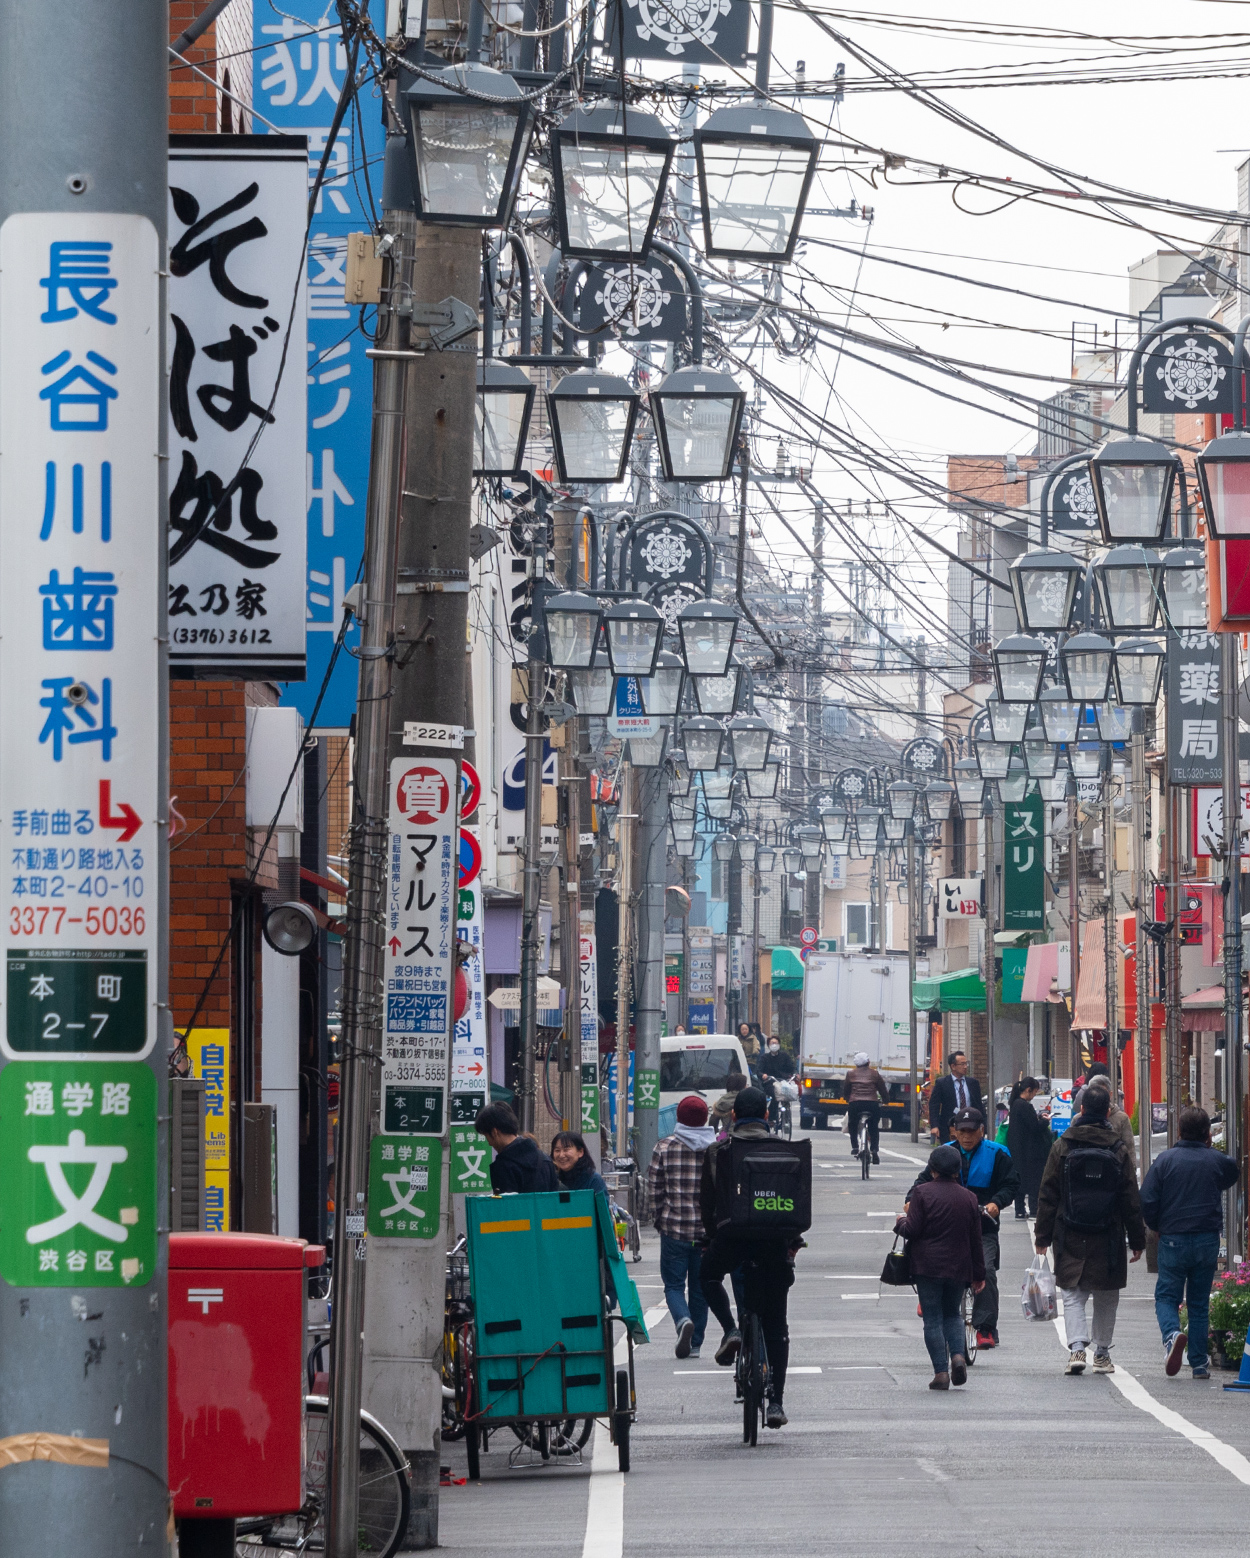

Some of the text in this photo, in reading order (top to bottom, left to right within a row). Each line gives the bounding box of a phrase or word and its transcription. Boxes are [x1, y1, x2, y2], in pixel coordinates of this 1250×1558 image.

[169, 181, 281, 568] そば処
[39, 241, 119, 763] 長谷川歯科
[173, 627, 272, 644] (3376)3612
[418, 728, 446, 740] 222
[401, 773, 445, 817] 質
[12, 809, 95, 836] 手前曲る
[12, 848, 144, 870] 不動通り路地入る
[12, 875, 144, 898] 本町2-40-10
[389, 834, 402, 931] 自転車販売しています
[403, 834, 437, 957] マルス
[9, 906, 146, 936] 3377-5036
[804, 932, 814, 941] 30
[473, 926, 482, 982] 医療人社団
[394, 965, 443, 978] 夜9時まで
[29, 973, 123, 1001] 本町
[388, 979, 448, 992] 日曜祝日も営業
[388, 996, 446, 1008] ブランドバッグ
[501, 992, 550, 1000] ケアステン本町
[389, 1008, 445, 1020] パソコン・家電
[42, 1012, 109, 1039] 2-7
[388, 1020, 445, 1031] 商品券・引越品
[386, 1035, 447, 1047] 渋・本町6-17-1
[386, 1048, 446, 1060] 不動通り坂下信号前
[201, 1044, 224, 1116] 自民党
[384, 1067, 446, 1081] 03-3374-5555
[25, 1082, 131, 1116] 通学路
[394, 1096, 437, 1110] 本町
[400, 1115, 430, 1127] 2-7
[210, 1131, 226, 1140] Lib
[381, 1144, 430, 1161] 通学路
[754, 1195, 794, 1212] eats
[385, 1219, 419, 1231] 渋谷区
[39, 1249, 115, 1272] 渋谷区
